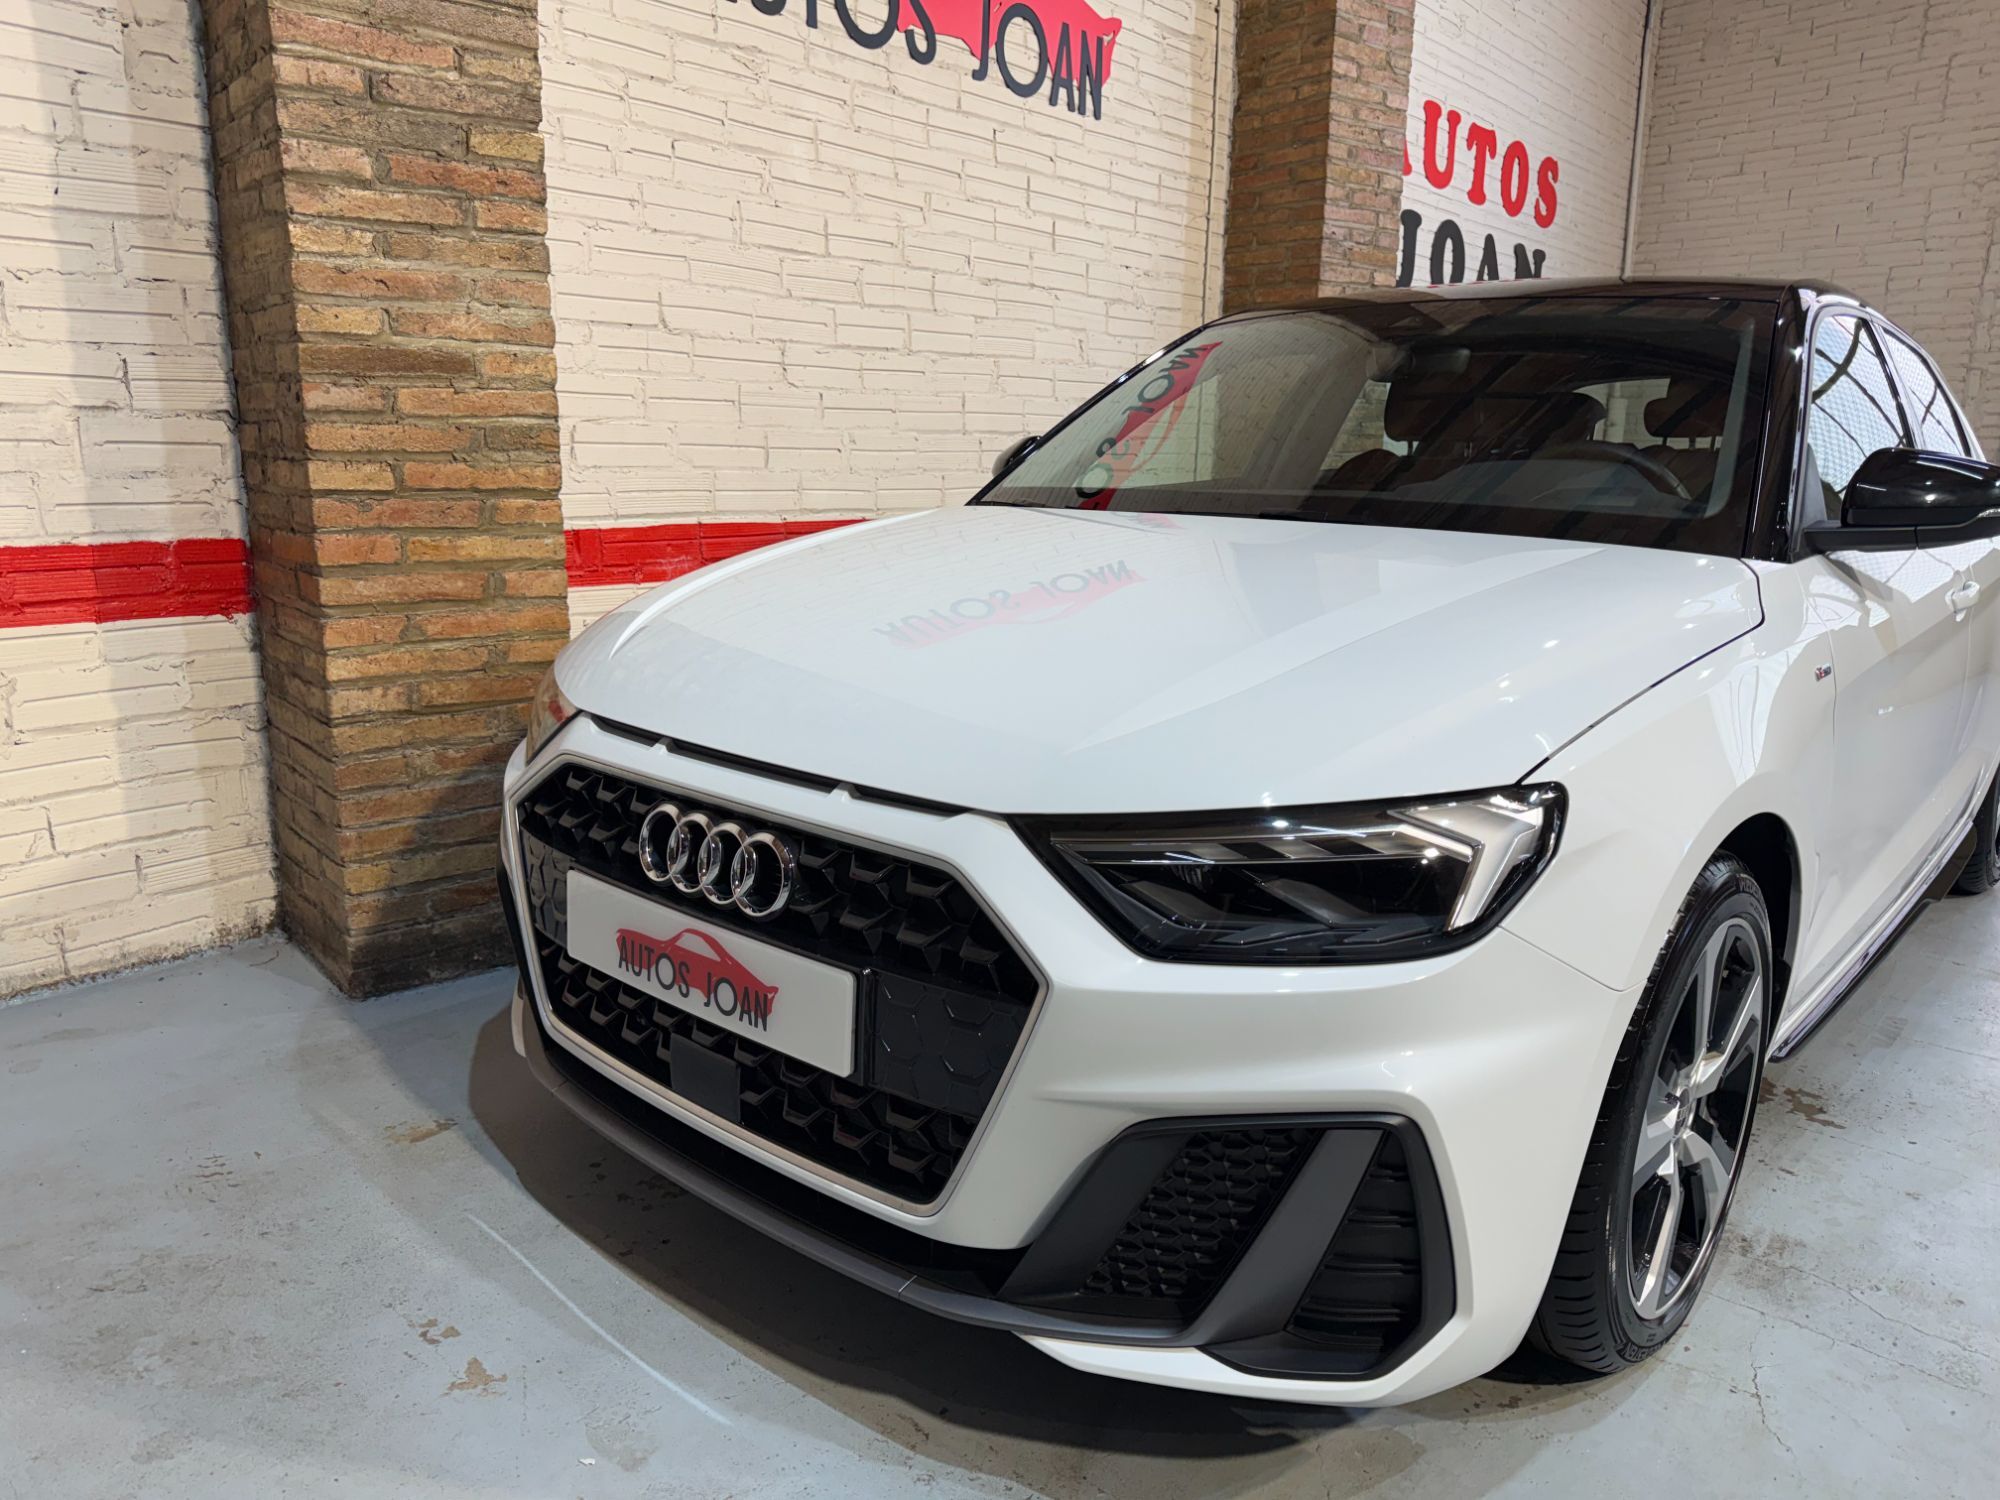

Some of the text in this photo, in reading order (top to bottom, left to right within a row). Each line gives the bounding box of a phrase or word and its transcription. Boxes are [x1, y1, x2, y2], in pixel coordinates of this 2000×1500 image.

[972, 0, 1102, 120] JOAN
[1402, 100, 1559, 229] UTOS
[618, 936, 770, 1032] AUTOS JOAN
